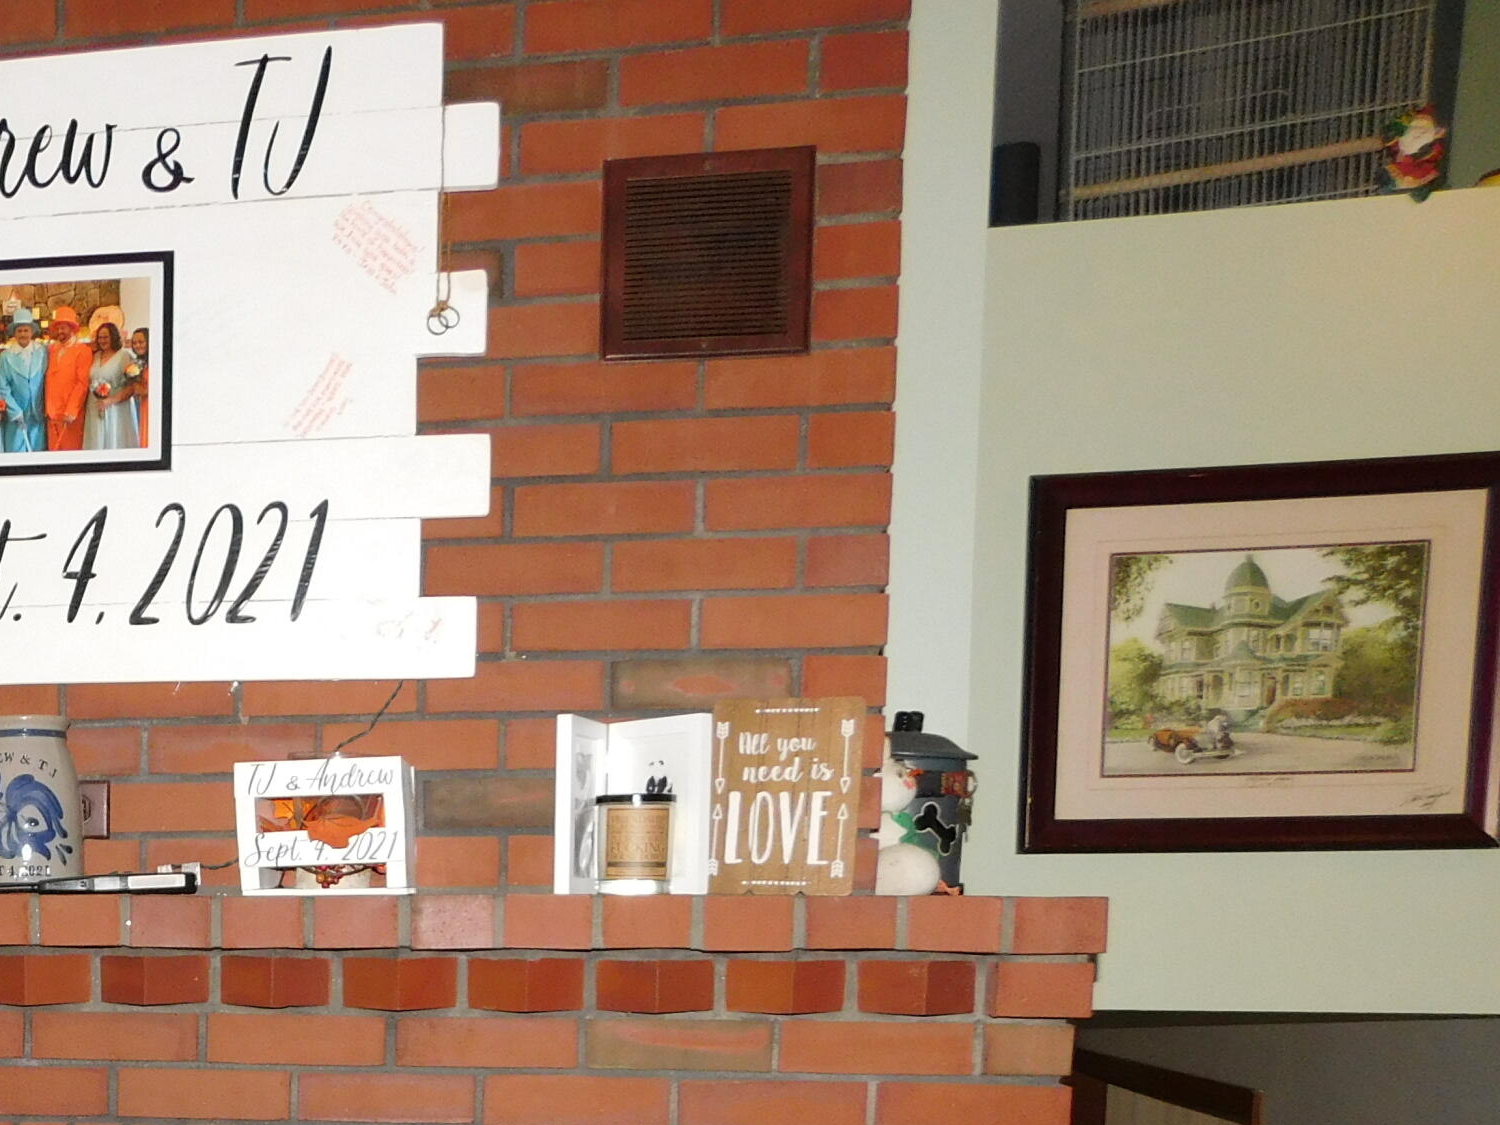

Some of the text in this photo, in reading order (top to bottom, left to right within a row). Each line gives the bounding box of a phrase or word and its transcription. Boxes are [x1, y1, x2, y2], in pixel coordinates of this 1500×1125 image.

[141, 127, 196, 193] &
[231, 45, 333, 199] TJ
[128, 499, 329, 625] 2021
[19, 754, 31, 765] &
[737, 731, 817, 762] All you
[286, 775, 302, 791] &
[306, 758, 395, 794] Andrew
[742, 756, 835, 783] need is
[724, 790, 832, 865] LOVE
[342, 831, 399, 861] 2021
